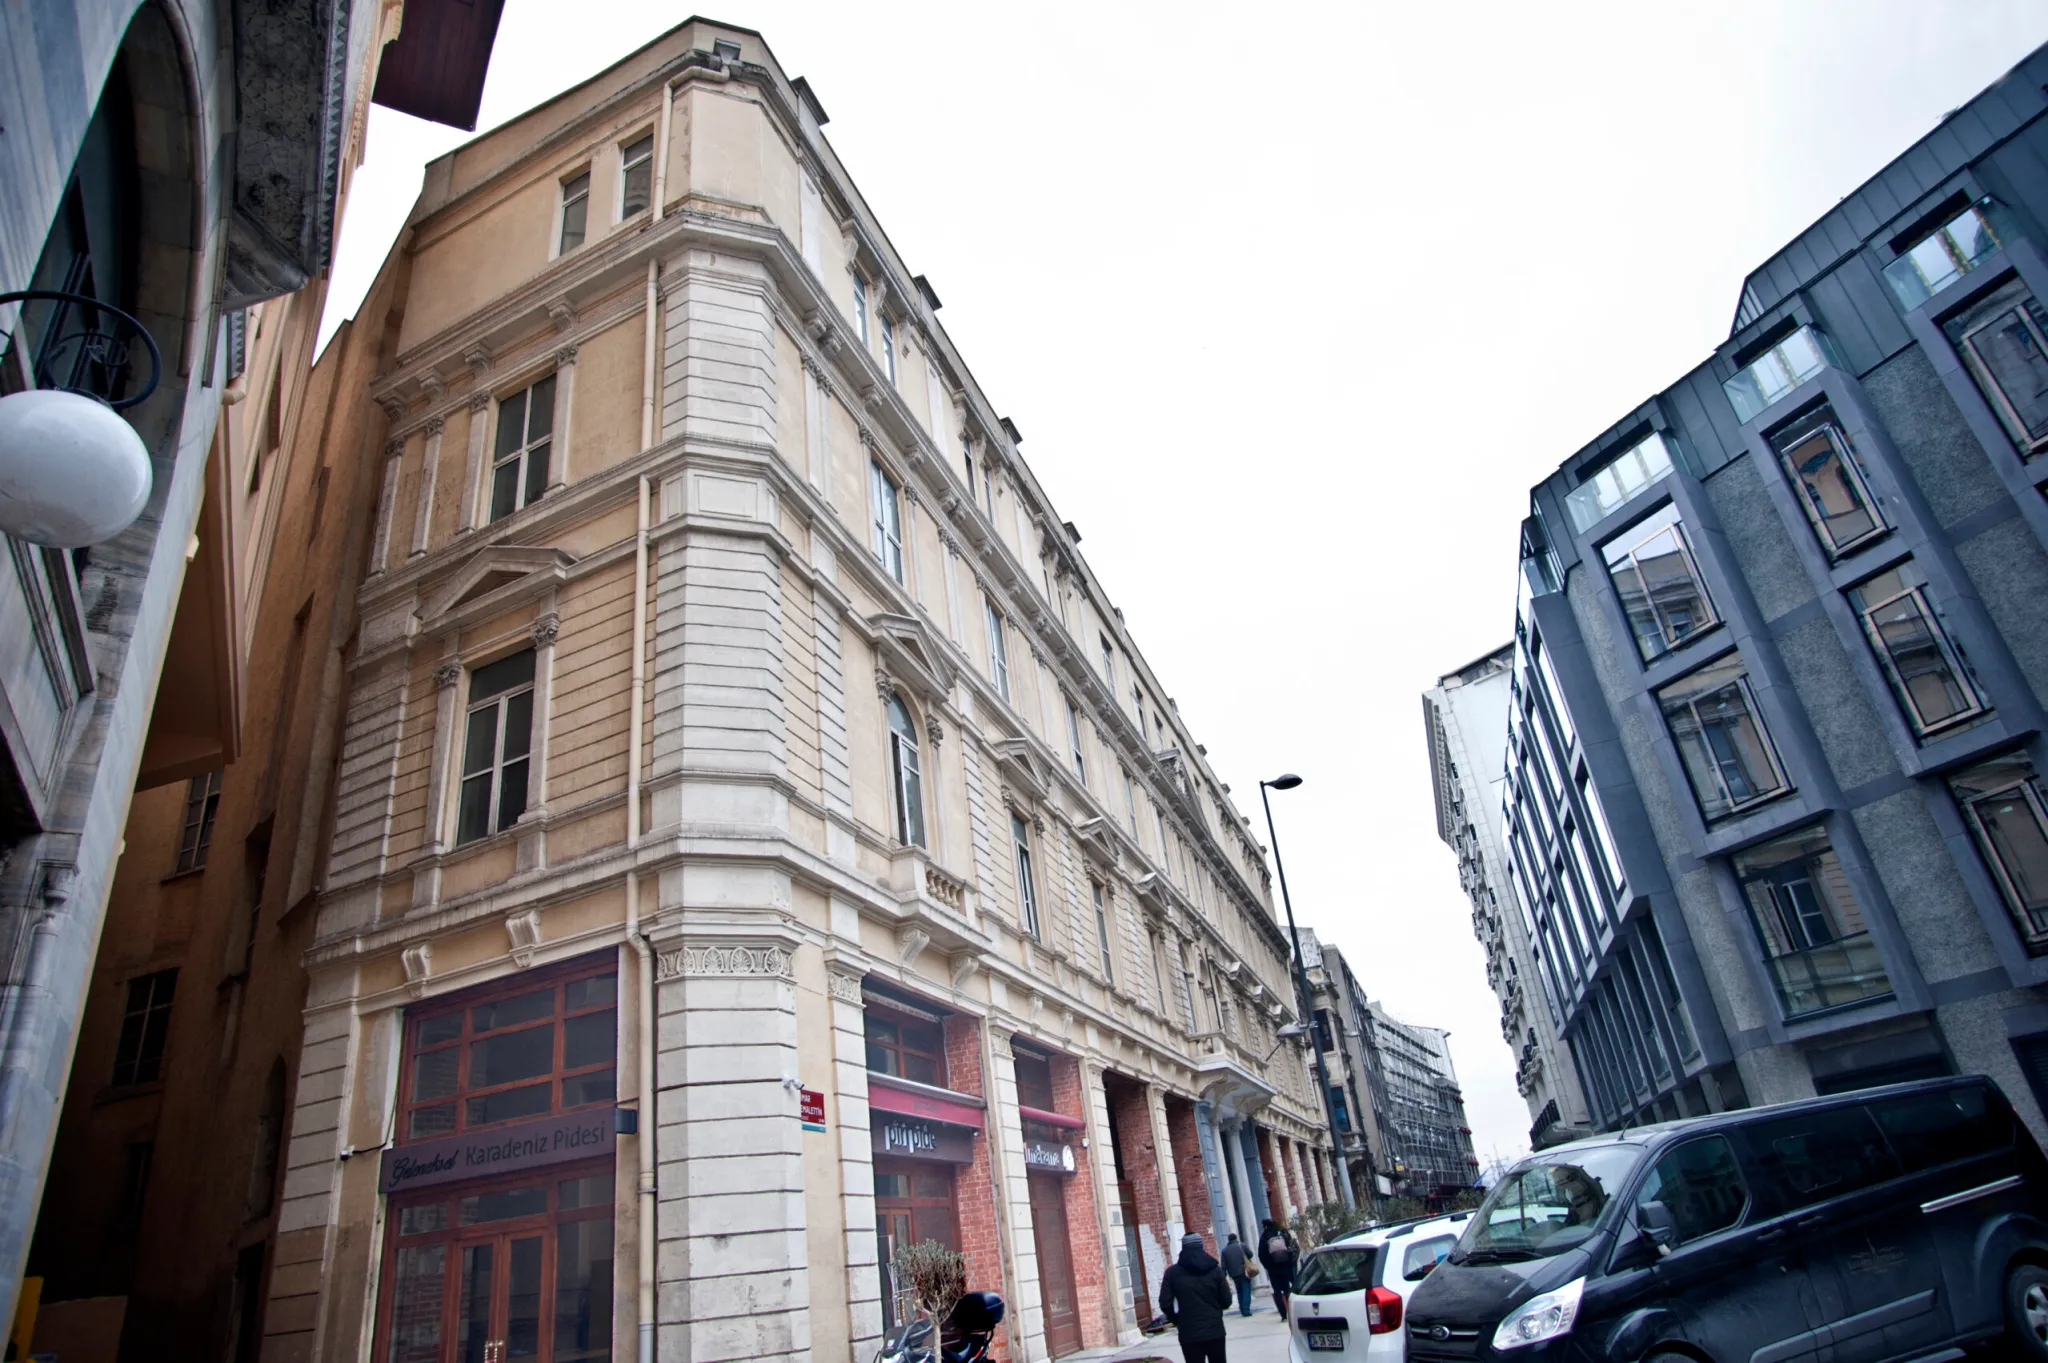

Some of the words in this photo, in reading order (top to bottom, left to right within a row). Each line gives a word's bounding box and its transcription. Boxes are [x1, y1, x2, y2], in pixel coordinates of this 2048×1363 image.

[801, 1094, 811, 1103] MAR
[801, 1106, 822, 1117] EMALETTİN
[389, 1150, 459, 1187] Geleneksel
[466, 1133, 547, 1166] Karadeniz
[553, 1121, 605, 1150] Pidesi
